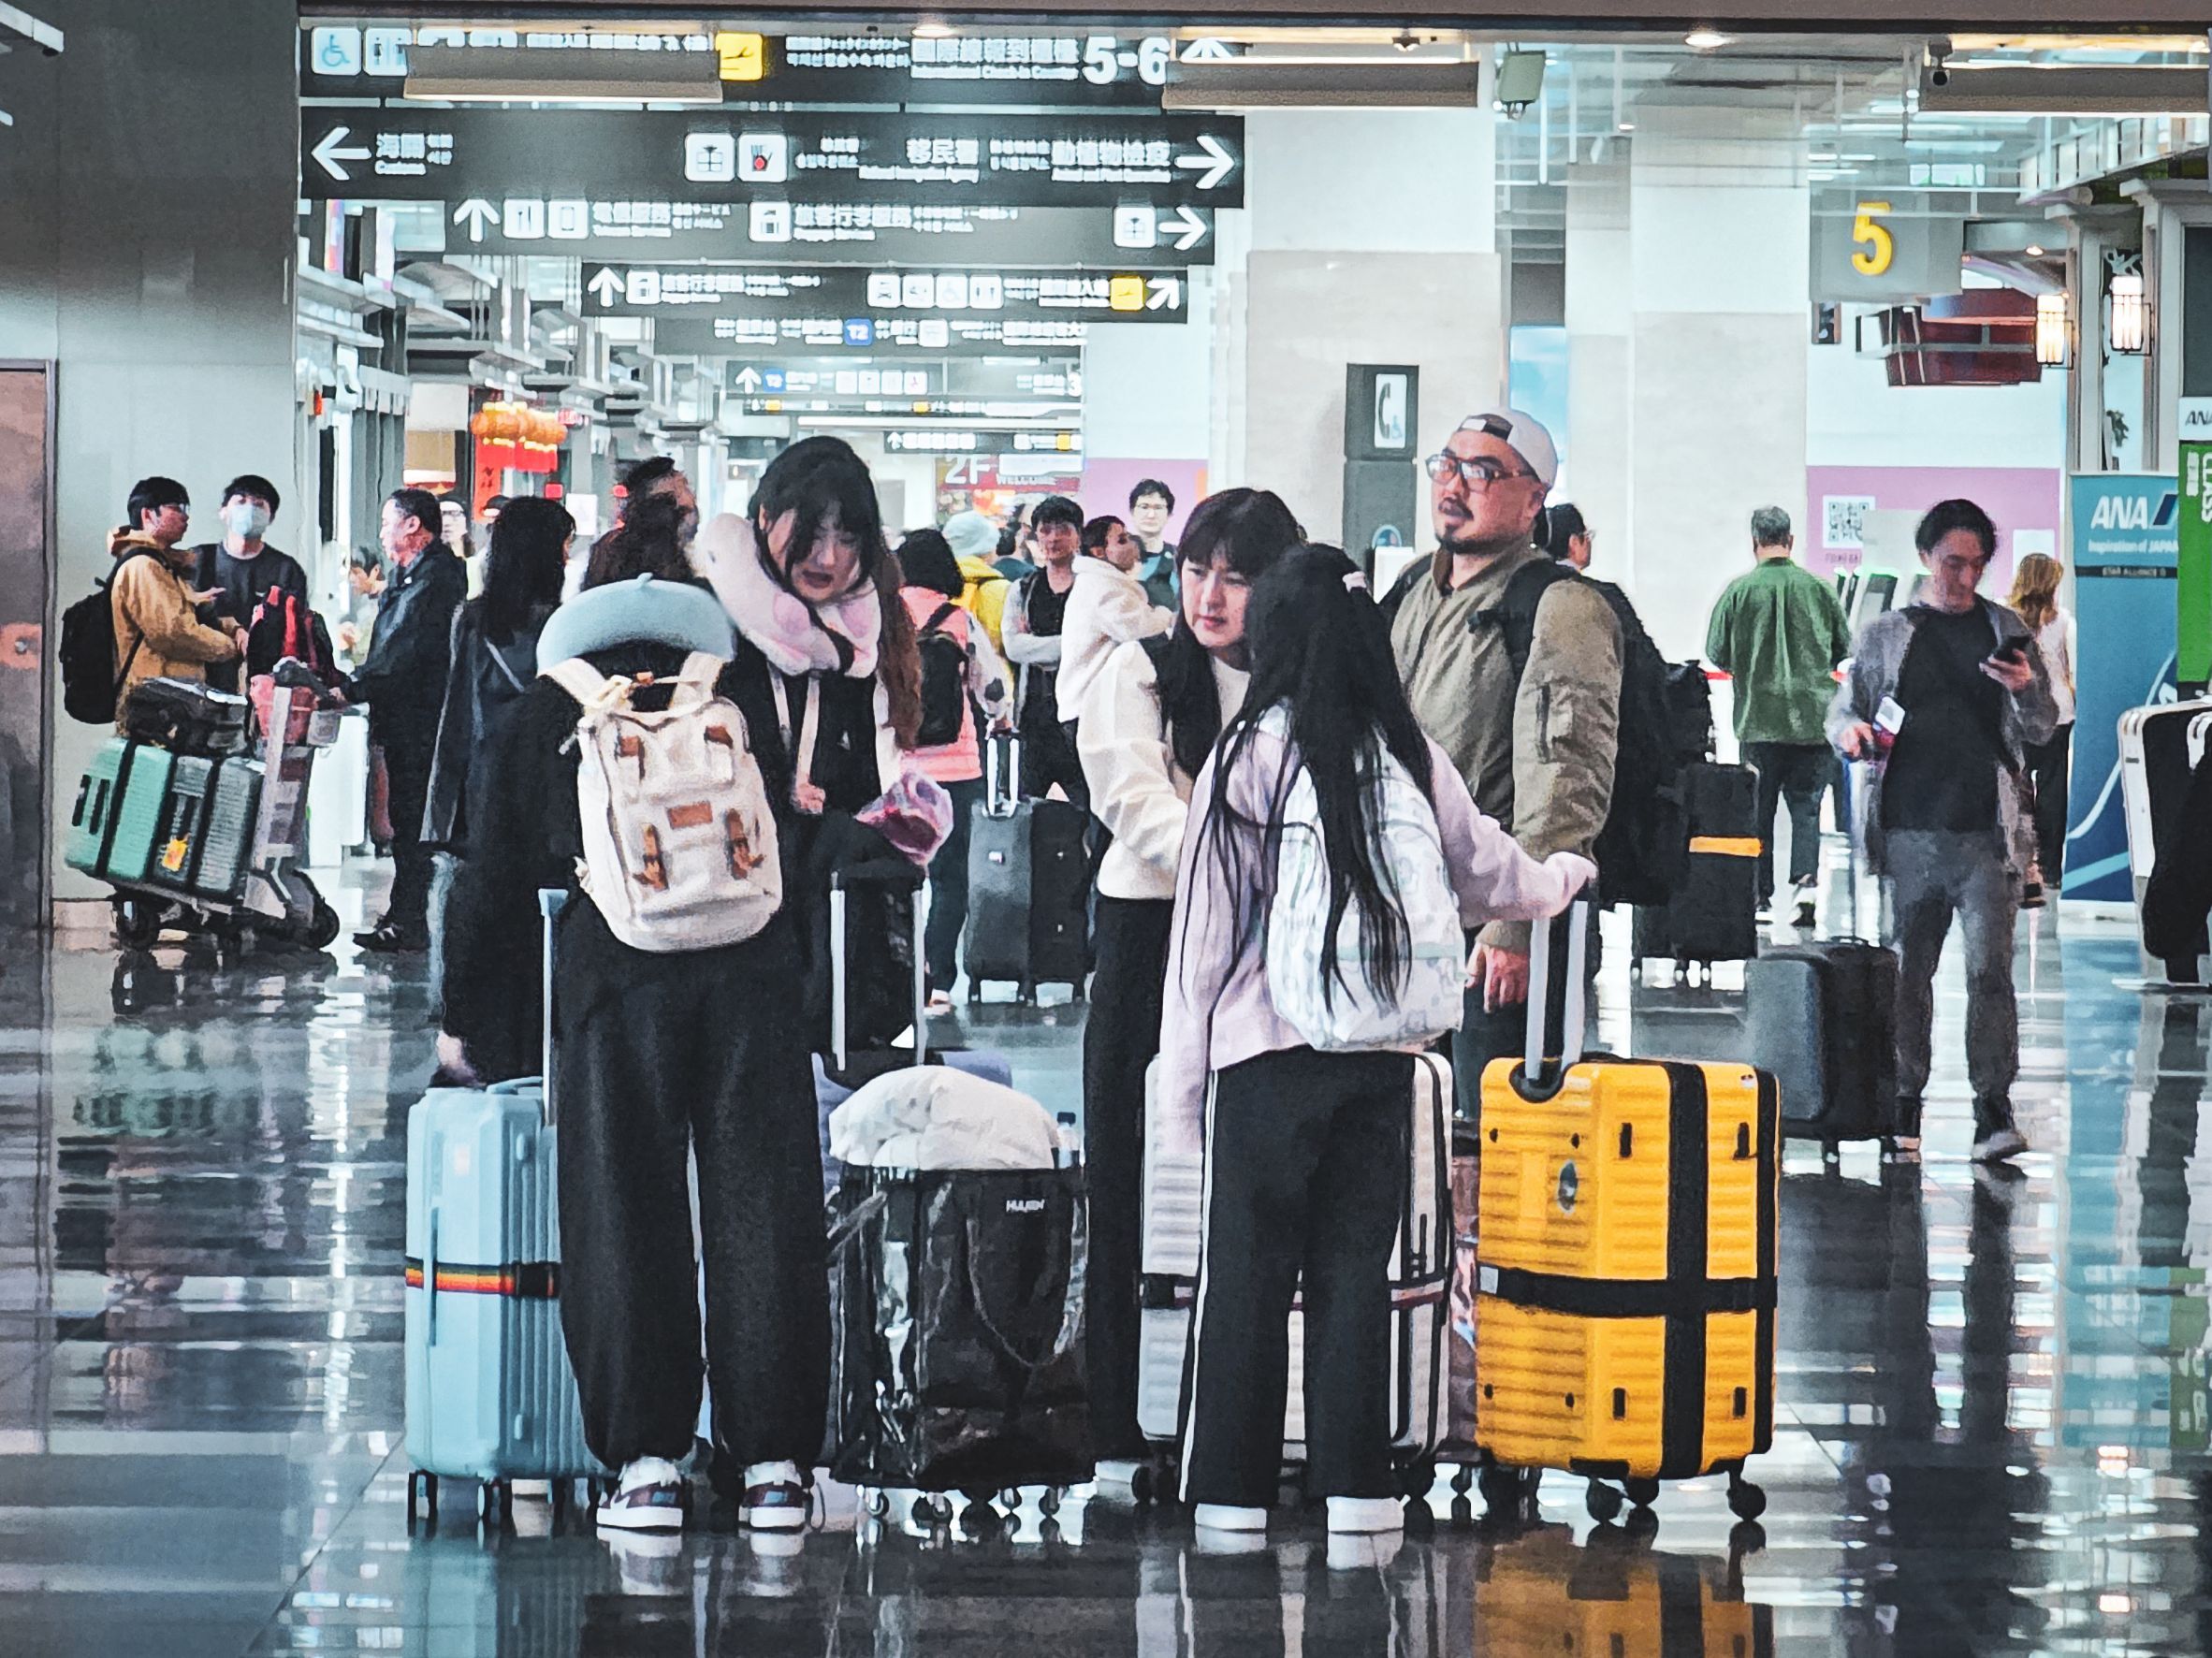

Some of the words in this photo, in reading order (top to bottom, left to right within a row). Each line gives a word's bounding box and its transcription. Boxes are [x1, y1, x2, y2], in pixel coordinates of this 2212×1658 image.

[1083, 36, 1171, 85] 5-6
[1852, 201, 1894, 276] 5
[1068, 374, 1082, 397] 3
[945, 454, 991, 485] 2F
[2090, 495, 2148, 530] ANA
